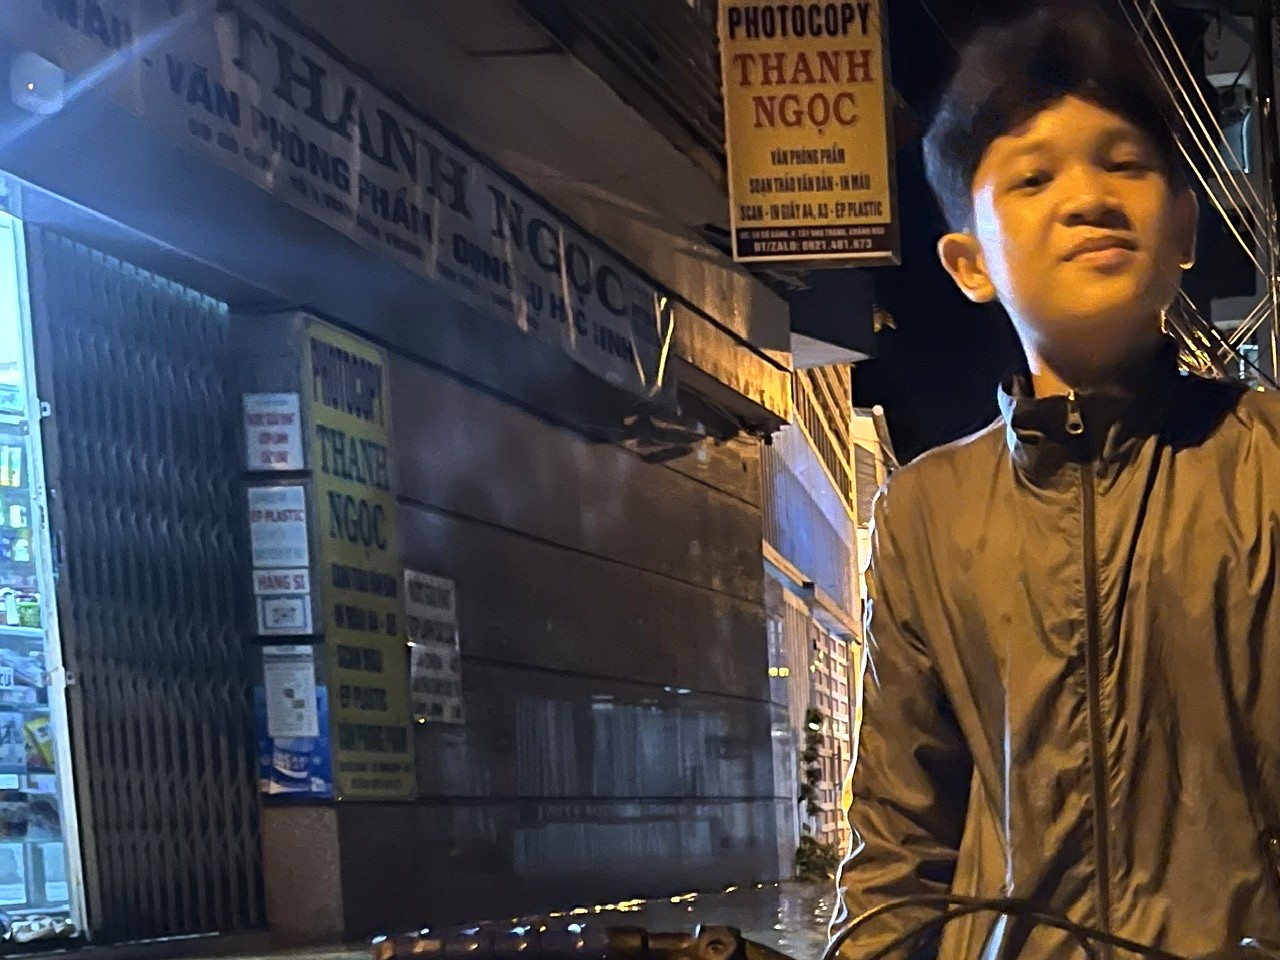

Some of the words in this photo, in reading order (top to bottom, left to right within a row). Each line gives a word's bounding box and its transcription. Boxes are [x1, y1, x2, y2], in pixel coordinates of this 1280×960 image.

[727, 2, 870, 40] PHOTOCOPY
[733, 49, 874, 87] THANH
[752, 92, 857, 136] NGỌC
[213, 0, 473, 222] THANH
[490, 186, 628, 318] NGỌC
[316, 424, 390, 492] THANH
